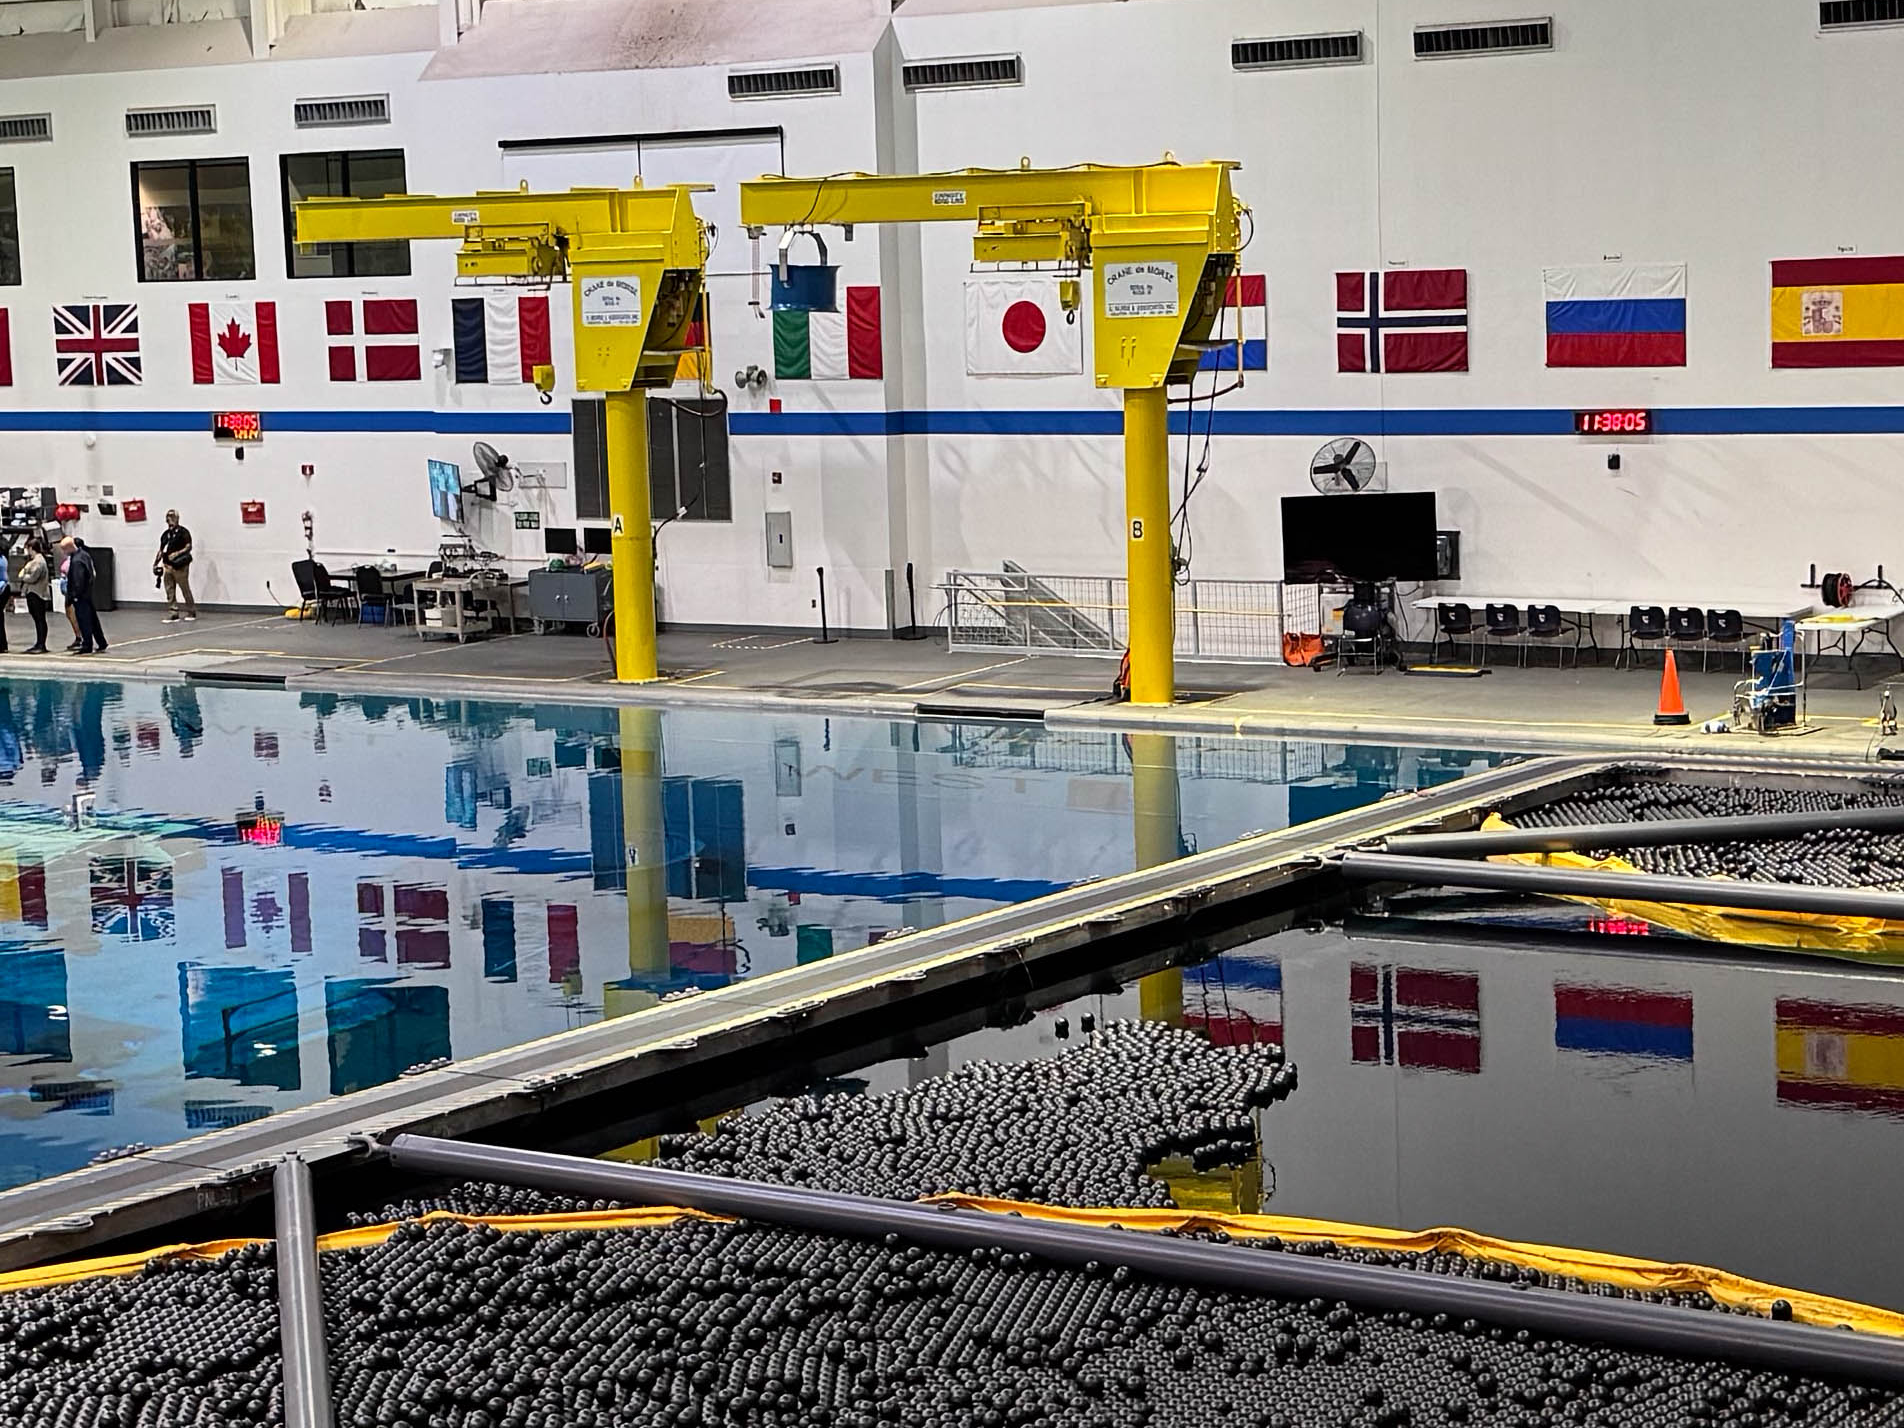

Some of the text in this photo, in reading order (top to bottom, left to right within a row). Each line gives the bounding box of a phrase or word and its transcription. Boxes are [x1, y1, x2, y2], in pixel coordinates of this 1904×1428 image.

[1107, 266, 1132, 285] CRANE
[1147, 265, 1175, 283] MORSE
[1583, 412, 1646, 431] 11:38:05
[614, 517, 623, 533] A
[1133, 520, 1143, 538] B
